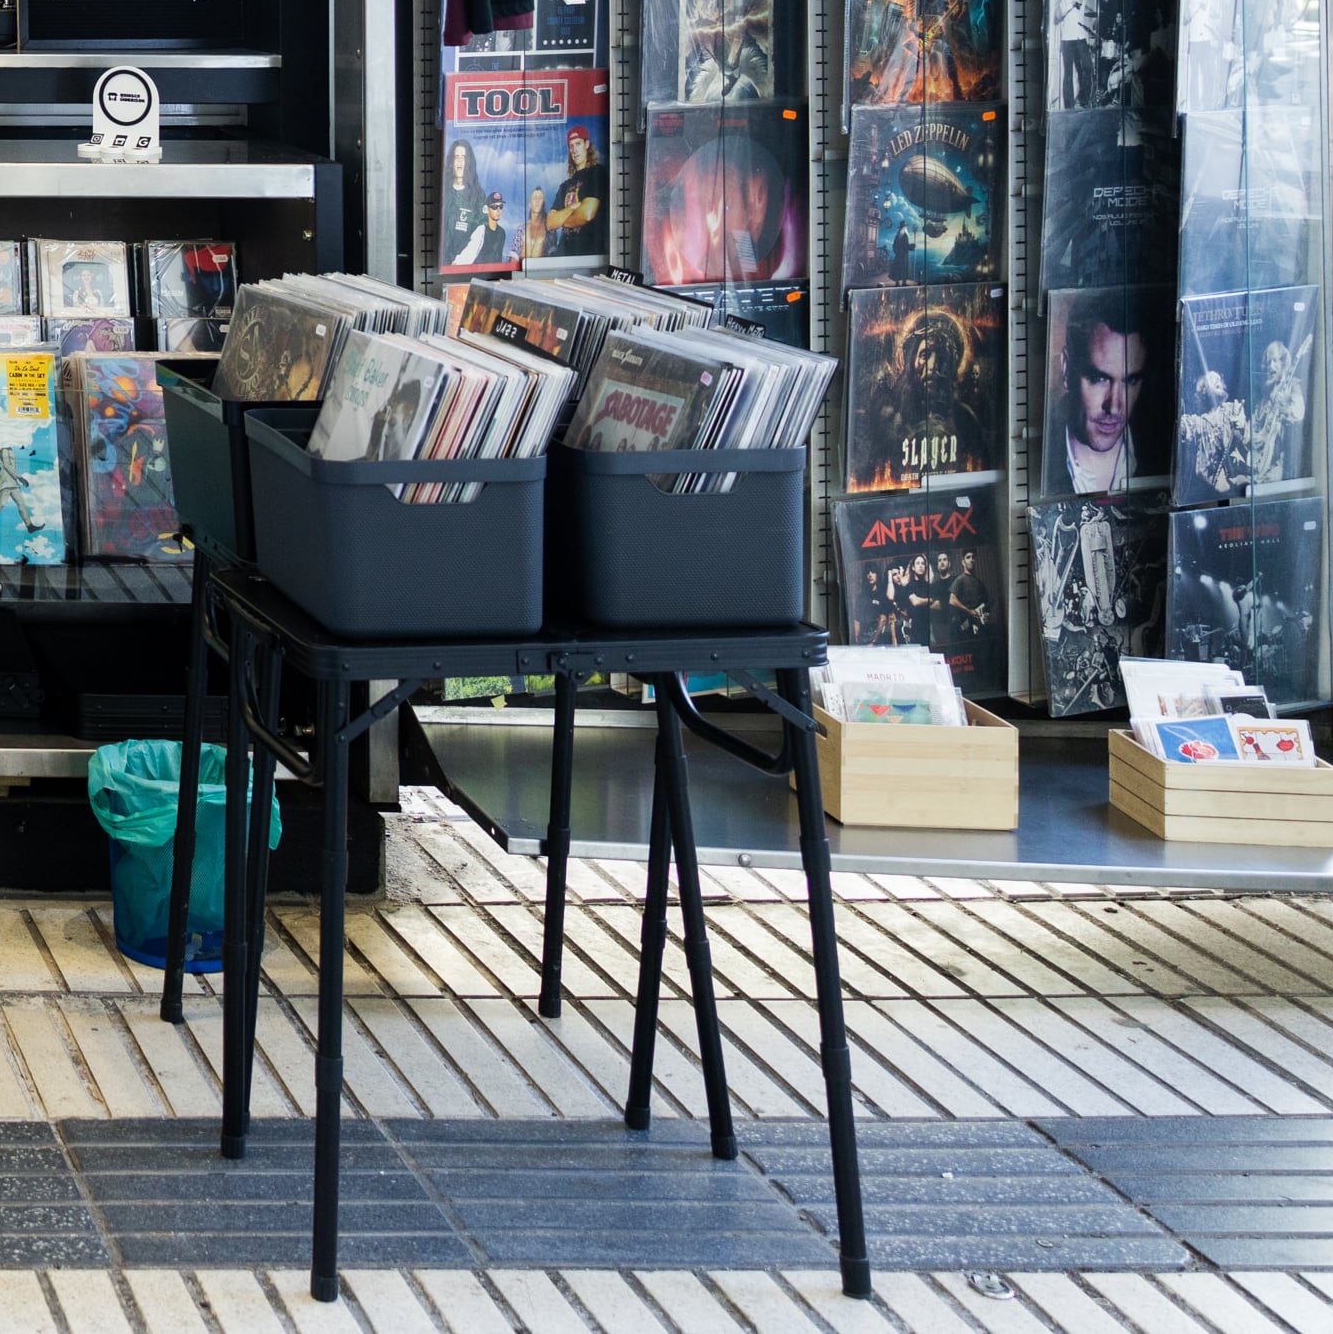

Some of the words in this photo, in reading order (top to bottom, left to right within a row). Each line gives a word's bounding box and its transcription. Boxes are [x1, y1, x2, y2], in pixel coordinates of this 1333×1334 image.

[460, 87, 561, 117] TOOL
[890, 131, 914, 156] LED
[912, 122, 971, 152] ZEPPELIN
[1107, 197, 1149, 208] MODE
[593, 388, 679, 439] SABOTAGE
[901, 434, 958, 470] SLAYER
[861, 507, 978, 550] ANTHRAX
[867, 672, 906, 683] MADRID
